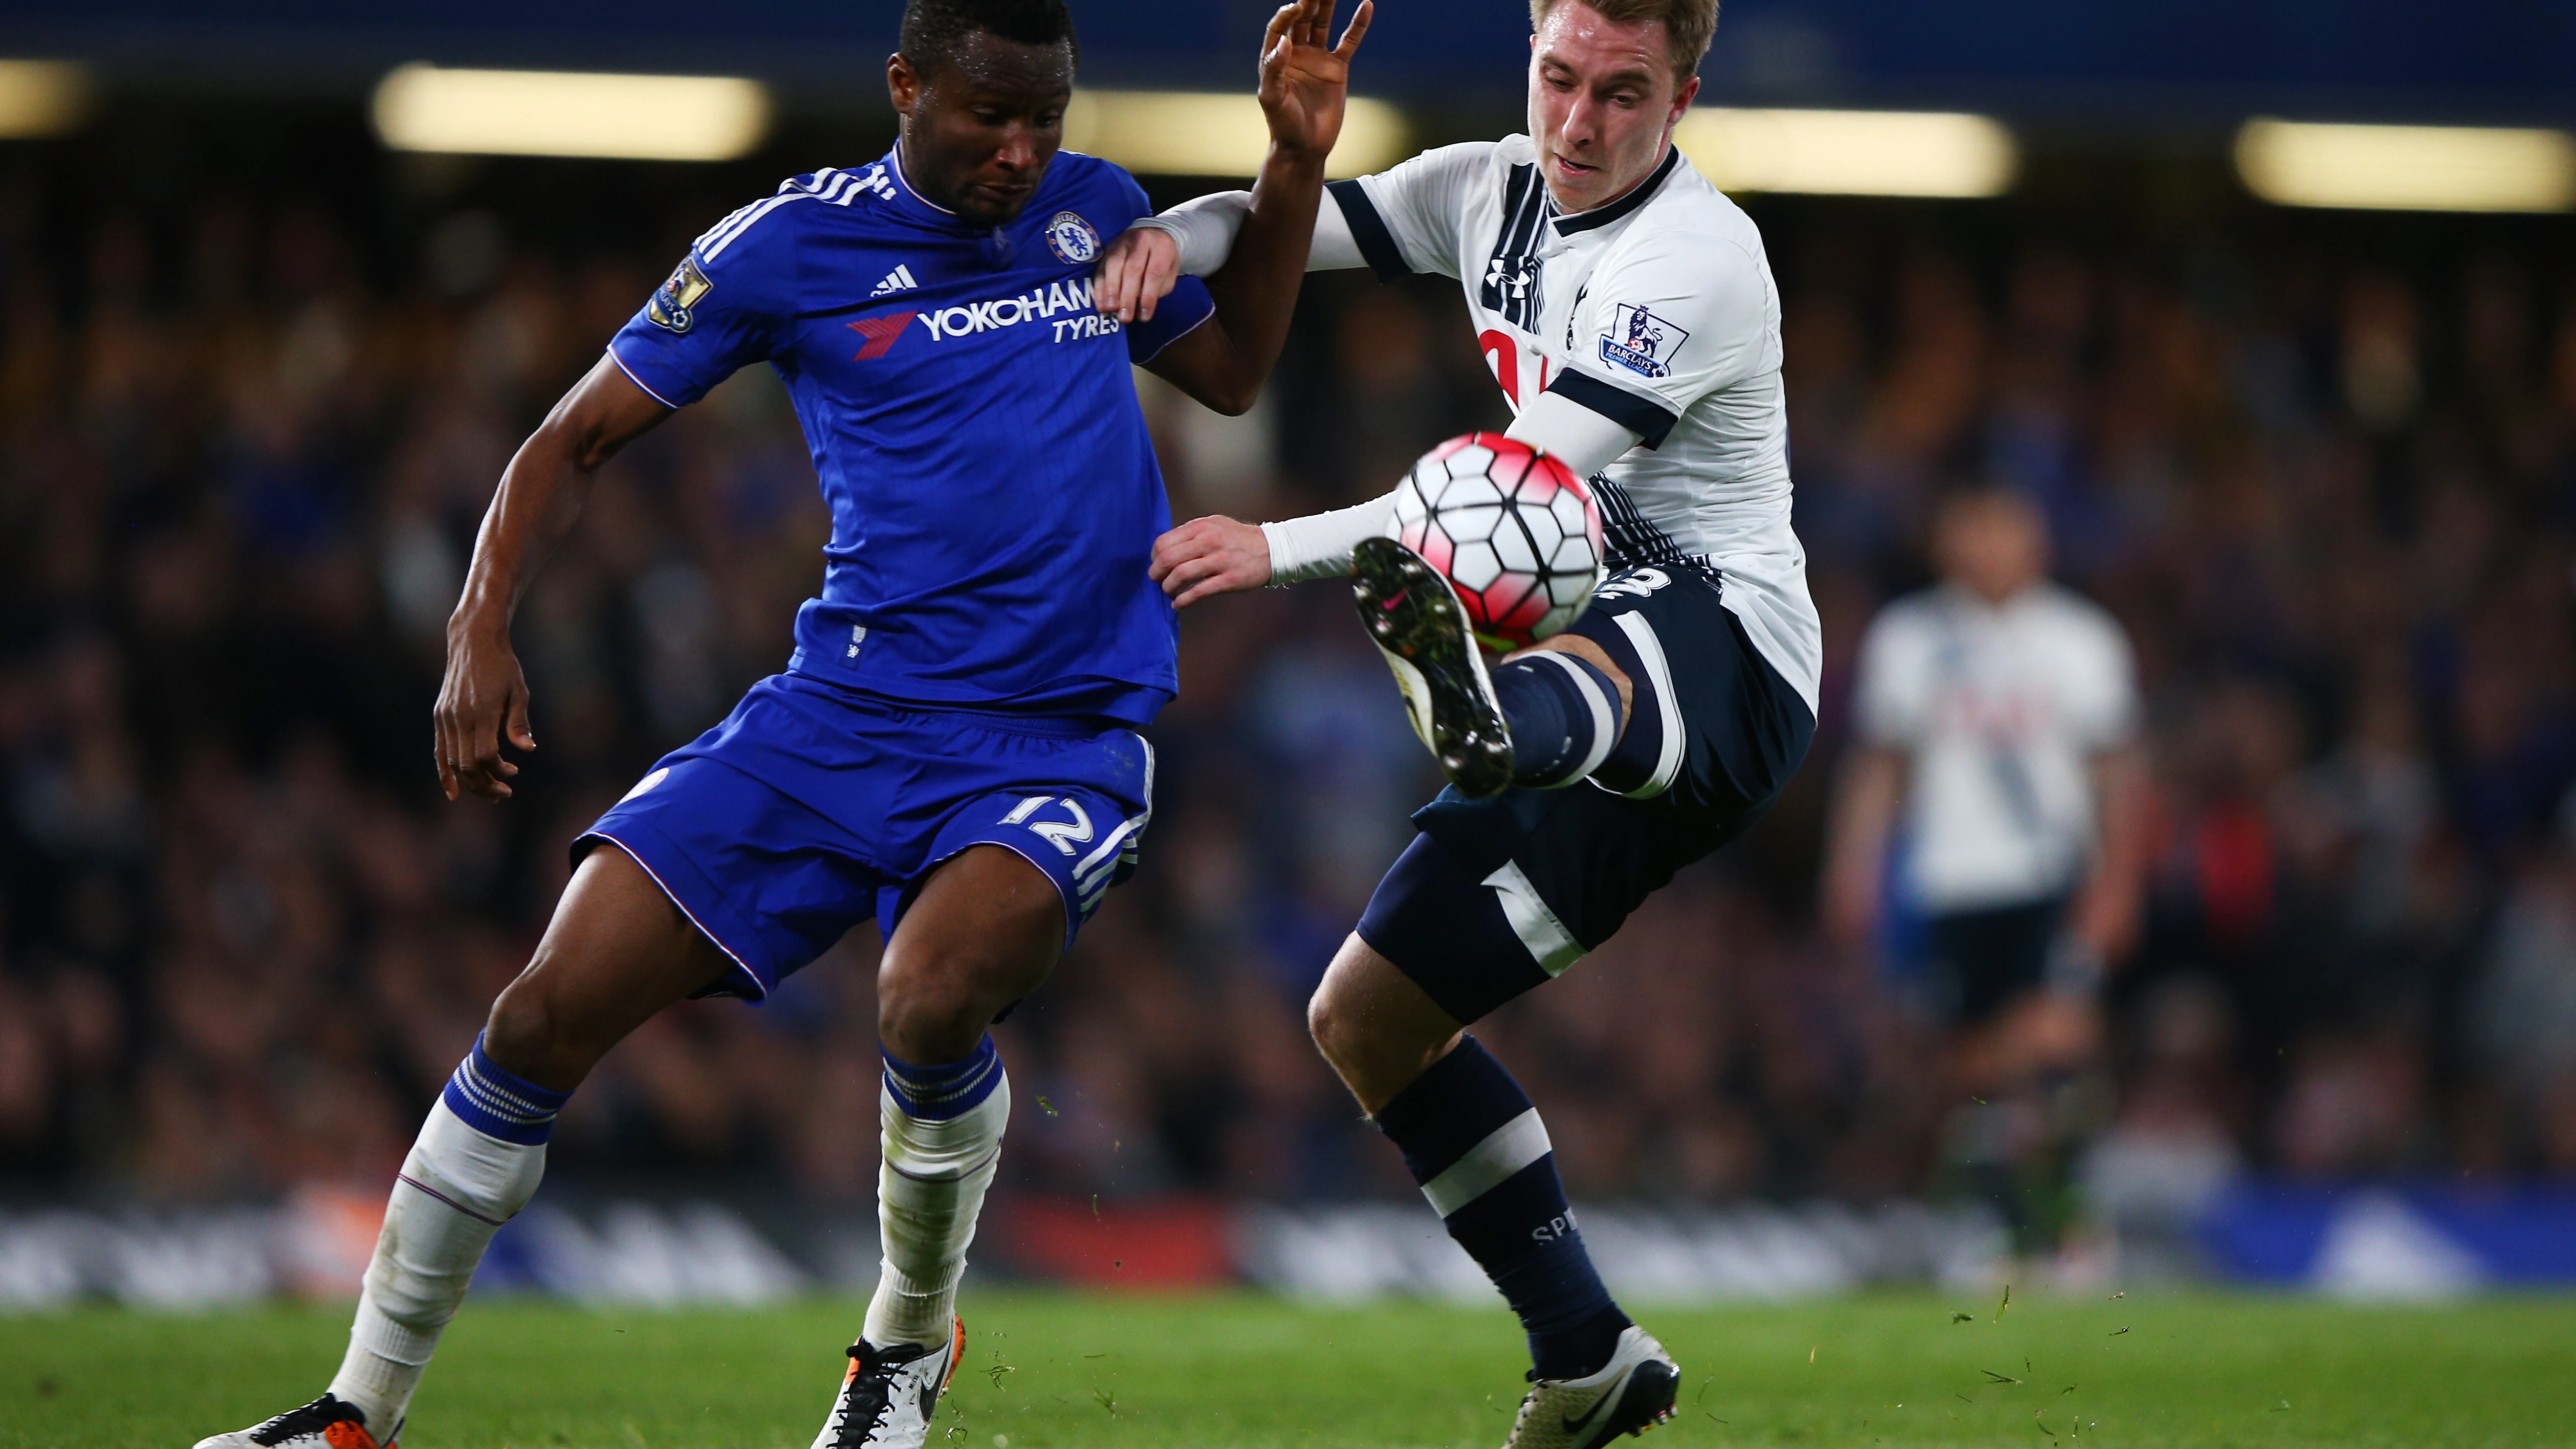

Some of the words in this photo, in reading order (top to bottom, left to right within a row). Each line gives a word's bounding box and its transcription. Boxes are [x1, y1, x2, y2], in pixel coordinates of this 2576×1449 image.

[916, 277, 1095, 342] YOKOHAM
[1052, 313, 1120, 343] TYRES
[1605, 352, 1627, 365] PREMIER
[1628, 362, 1650, 375] LEAGUE
[1608, 344, 1652, 369] BARCLAYS
[996, 796, 1094, 855] 12
